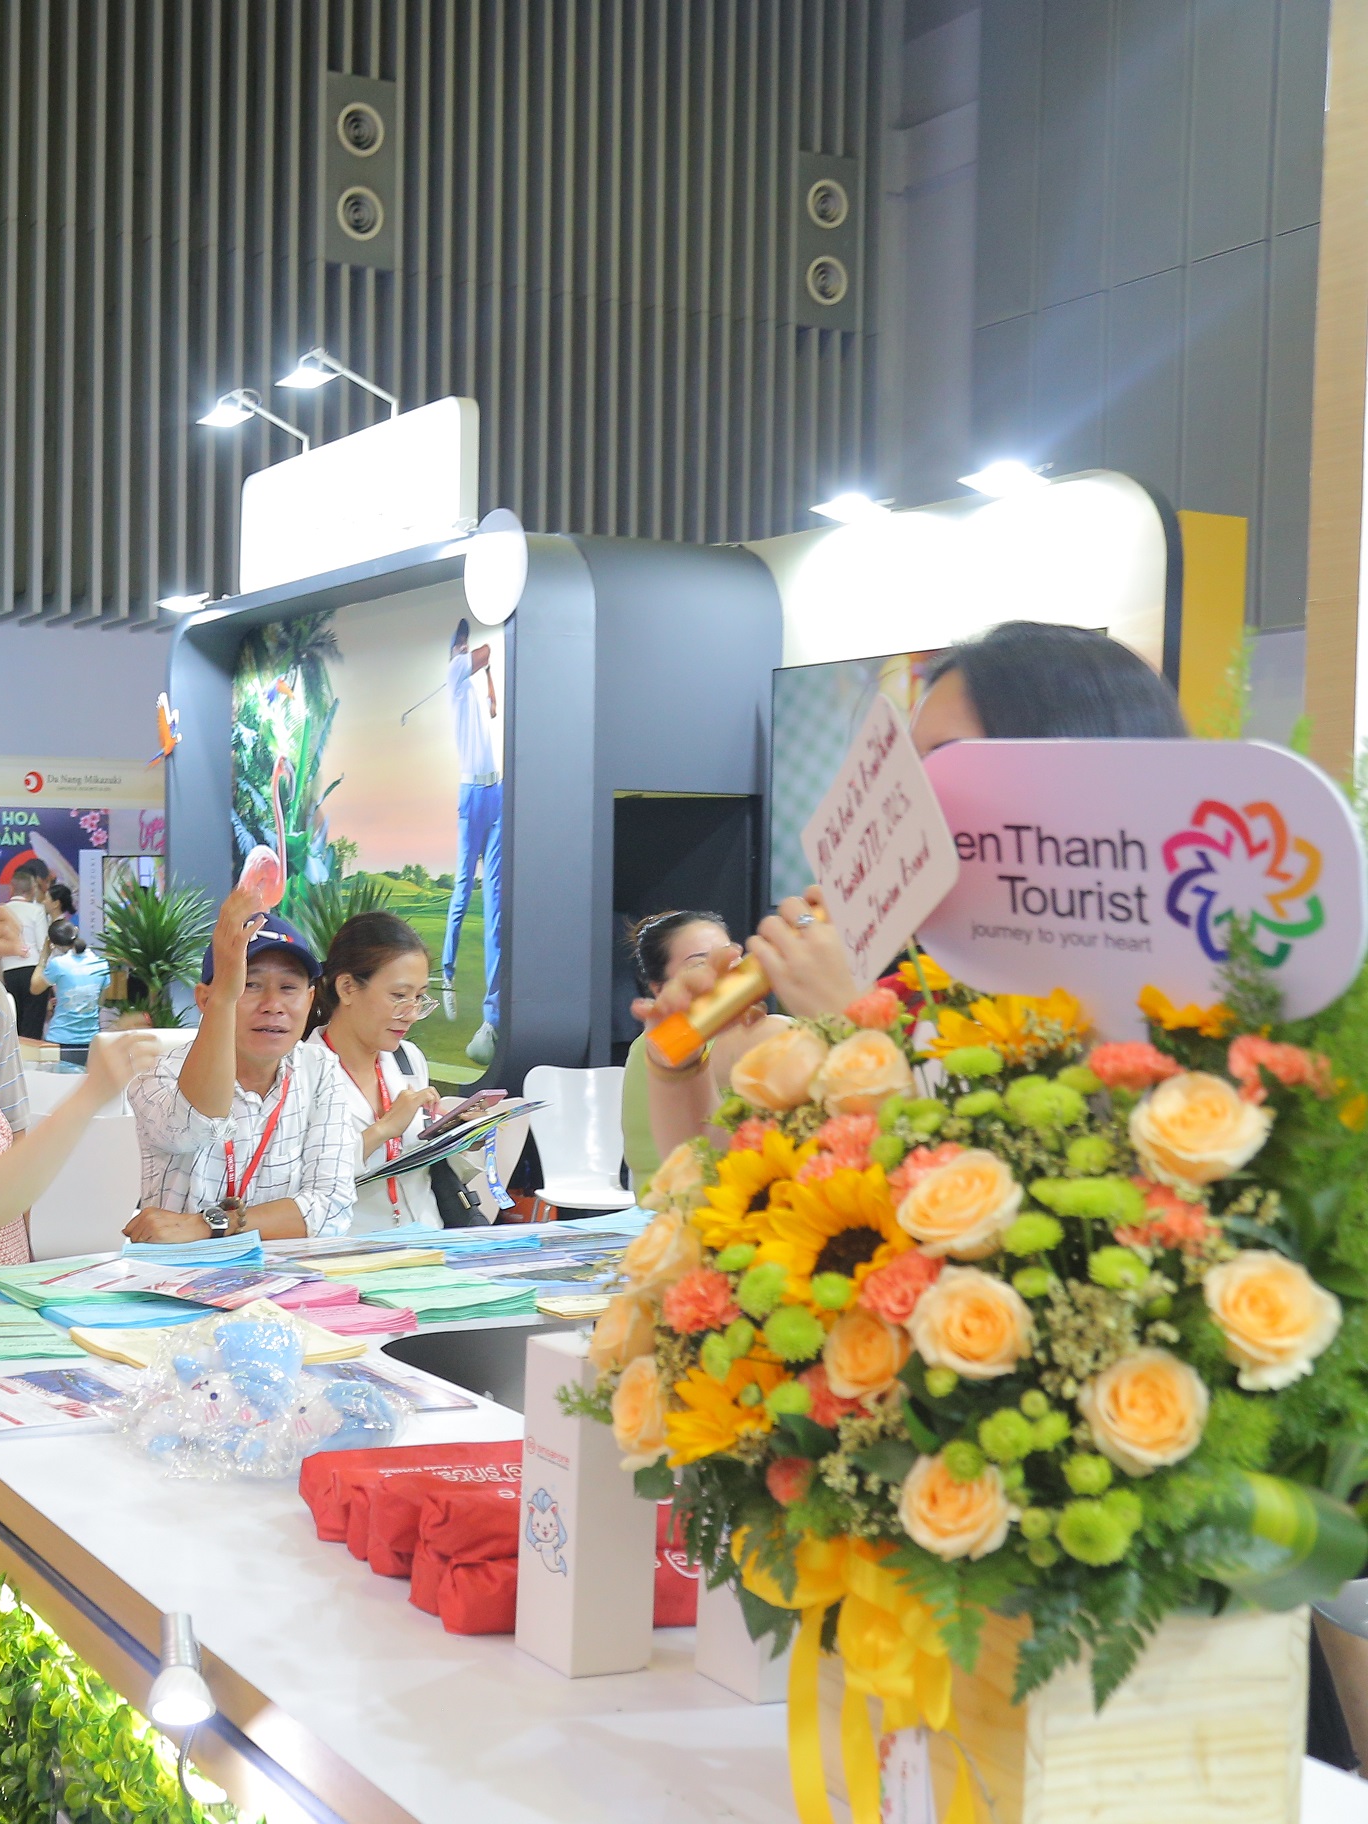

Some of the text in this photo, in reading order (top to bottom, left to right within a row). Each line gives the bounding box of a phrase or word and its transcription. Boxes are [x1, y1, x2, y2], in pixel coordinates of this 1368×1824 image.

[1, 811, 40, 827] HOA
[954, 825, 1147, 872] enThanh
[997, 875, 1150, 925] Tourist
[971, 922, 1153, 953] journey to your heart
